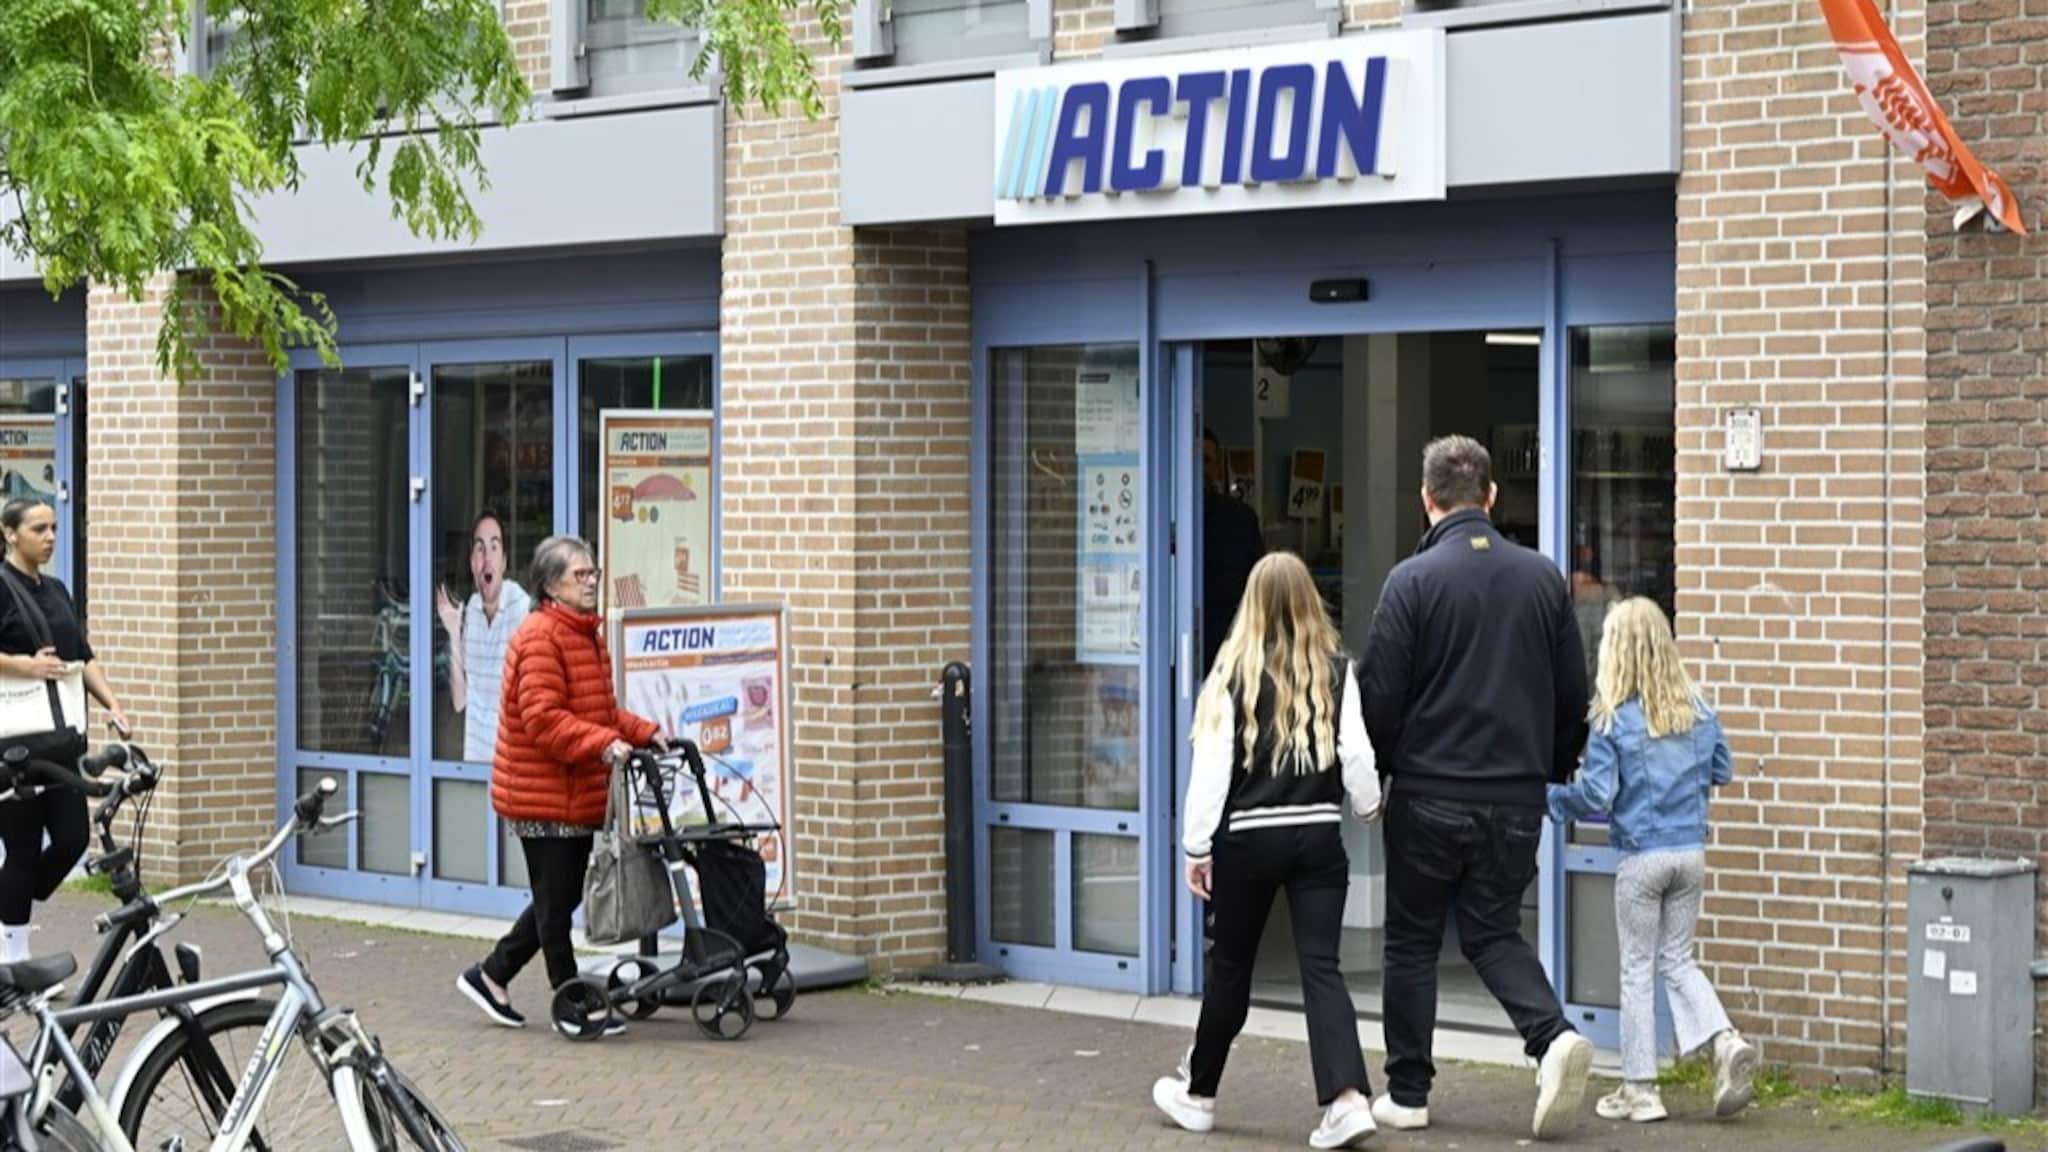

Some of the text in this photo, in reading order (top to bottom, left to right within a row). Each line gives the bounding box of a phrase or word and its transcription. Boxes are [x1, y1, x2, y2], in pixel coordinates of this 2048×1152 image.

[1044, 57, 1388, 197] ACTION
[1258, 378, 1269, 400] 2
[620, 432, 667, 451] ACTION
[643, 626, 715, 652] ACTION
